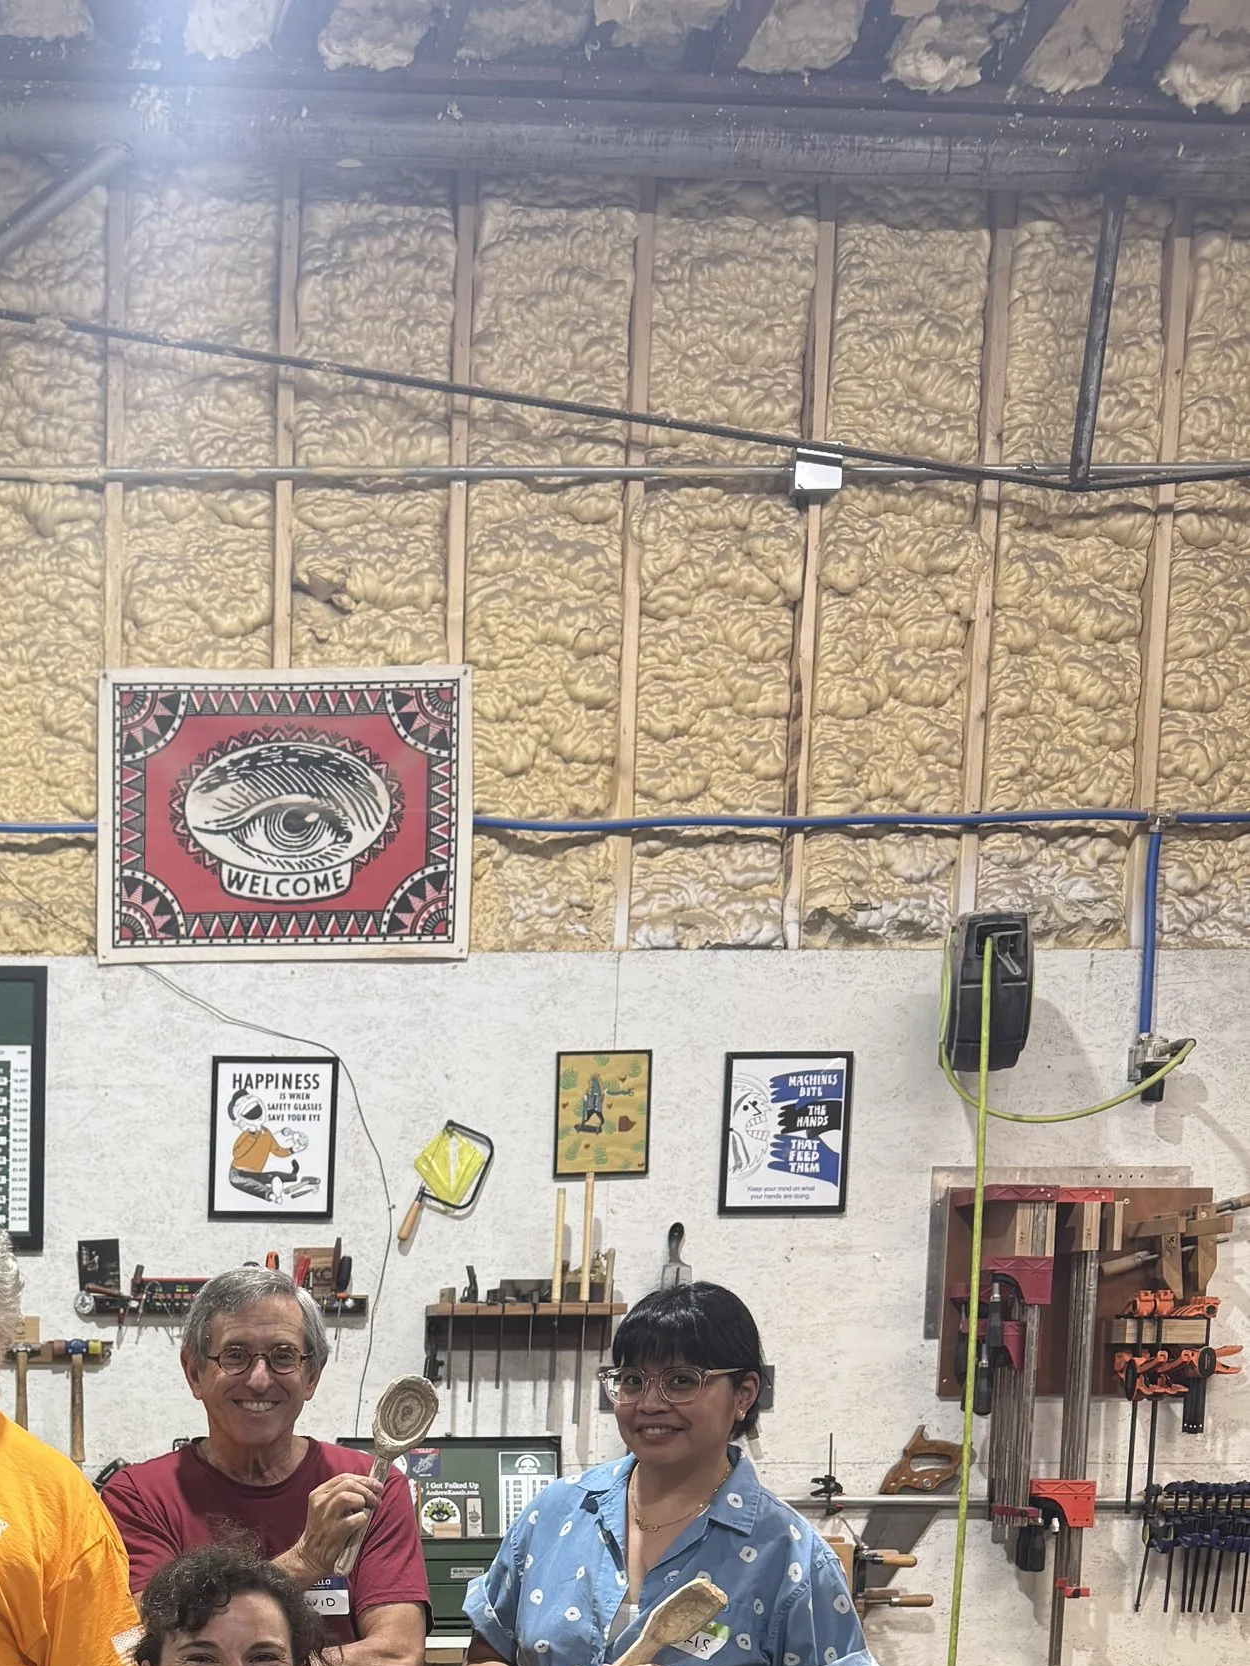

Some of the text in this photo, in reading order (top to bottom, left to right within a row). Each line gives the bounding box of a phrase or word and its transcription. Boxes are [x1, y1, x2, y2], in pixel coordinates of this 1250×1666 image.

[227, 868, 345, 897] WELCOME
[232, 1073, 320, 1090] HAPPINESS
[788, 1074, 838, 1087] MACHINES
[280, 1092, 310, 1100] IS WHEN
[800, 1086, 822, 1097] BITE
[294, 1103, 322, 1111] GLASSES
[807, 1104, 826, 1116] THE
[796, 1115, 829, 1128] HANDS
[790, 1139, 820, 1150] THAT
[788, 1151, 820, 1162] FEED
[788, 1162, 820, 1173] THEM
[468, 1482, 479, 1490] Up
[314, 1578, 331, 1586] LLO
